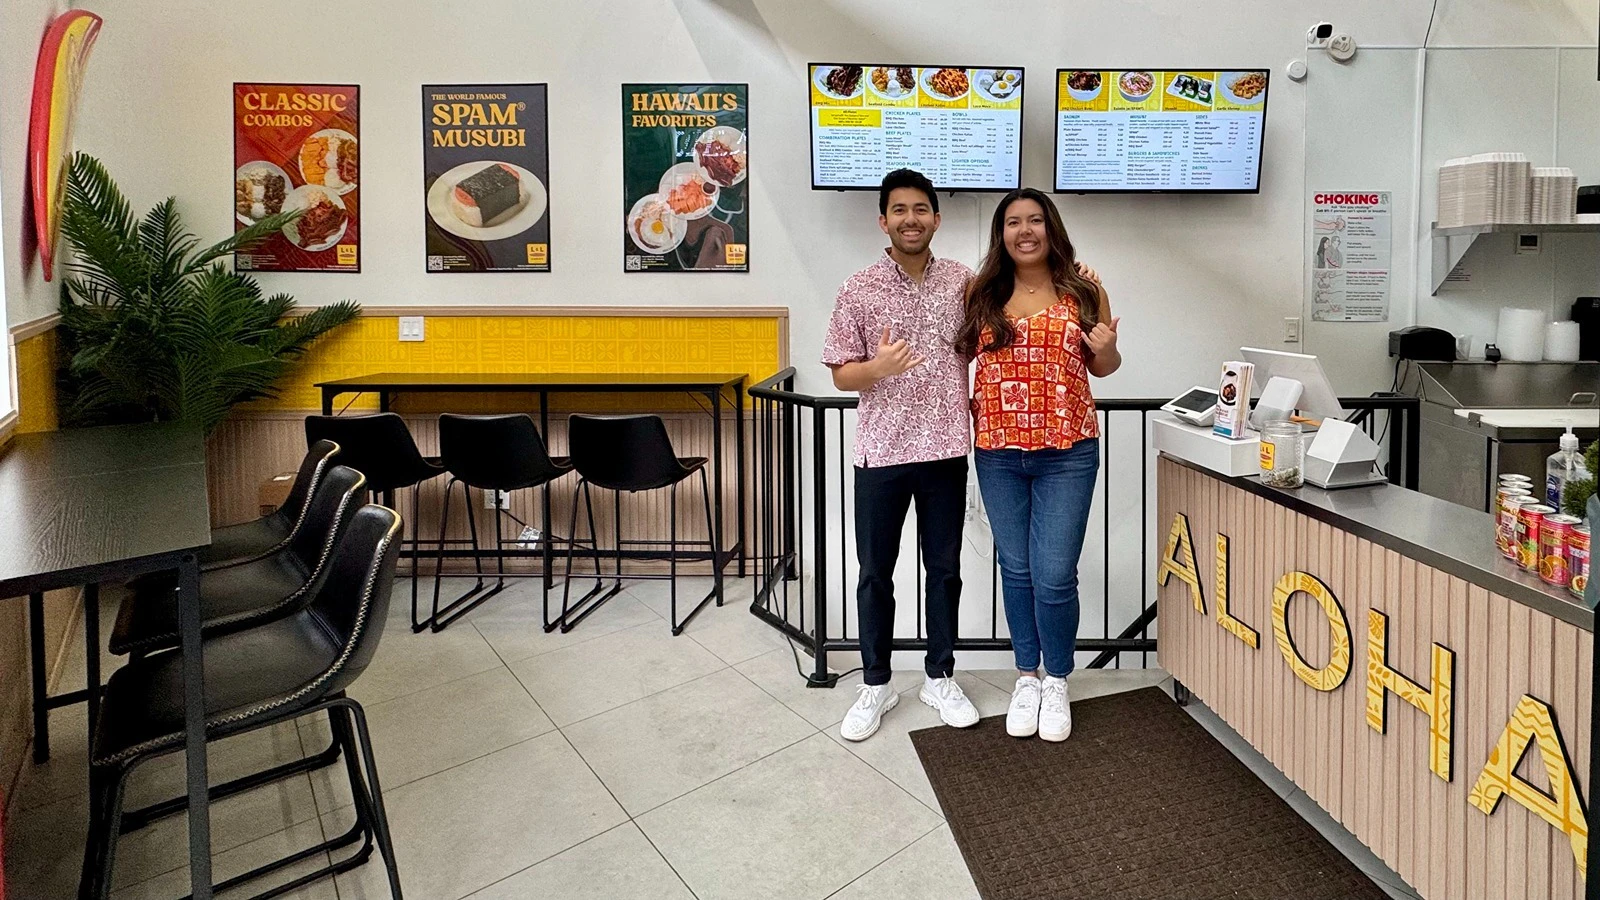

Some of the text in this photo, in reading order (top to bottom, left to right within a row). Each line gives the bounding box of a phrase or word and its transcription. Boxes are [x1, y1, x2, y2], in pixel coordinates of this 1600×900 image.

[243, 93, 346, 112] CLASSIC
[632, 93, 737, 111] HAWAII'S
[244, 115, 313, 127] COMBOS
[632, 115, 717, 127] FAVORITES
[433, 129, 526, 147] MUSUBI
[1314, 194, 1378, 204] CHOKING
[1158, 512, 1588, 884] ALOHA
